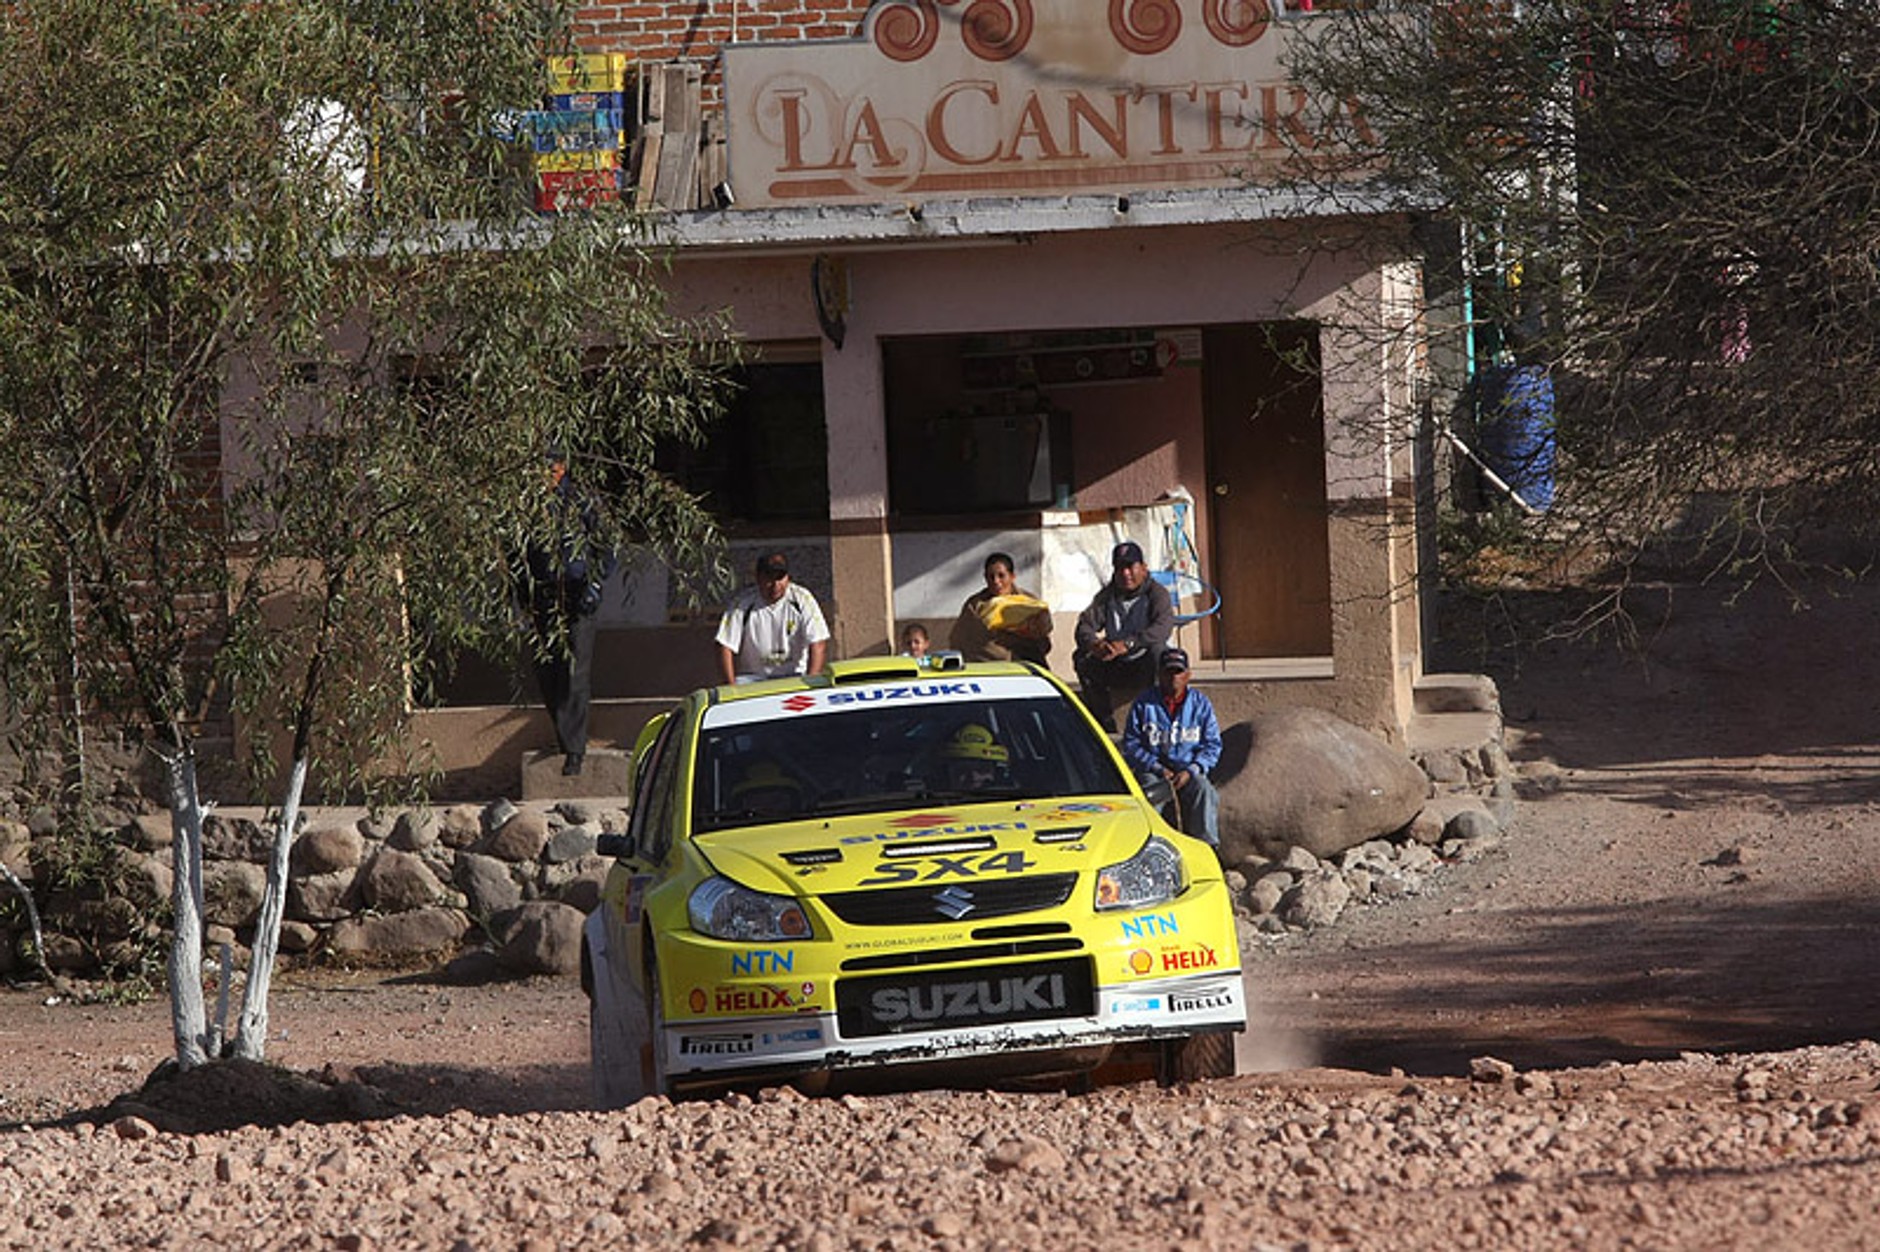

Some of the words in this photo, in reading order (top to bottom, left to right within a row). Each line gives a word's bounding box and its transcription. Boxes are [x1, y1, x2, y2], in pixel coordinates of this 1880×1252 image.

[774, 88, 901, 173] LA
[827, 683, 982, 705] SUZUKI
[840, 821, 1028, 844] SUZUKI
[857, 850, 1036, 886] SX4
[1120, 911, 1179, 938] NTN
[732, 950, 794, 974] NTN
[1162, 948, 1218, 971] HELIX
[716, 989, 792, 1012] HELIX
[871, 973, 1066, 1021] SUZUKI
[1167, 987, 1233, 1013] PIRELLI
[679, 1033, 754, 1055] PIRELLI
